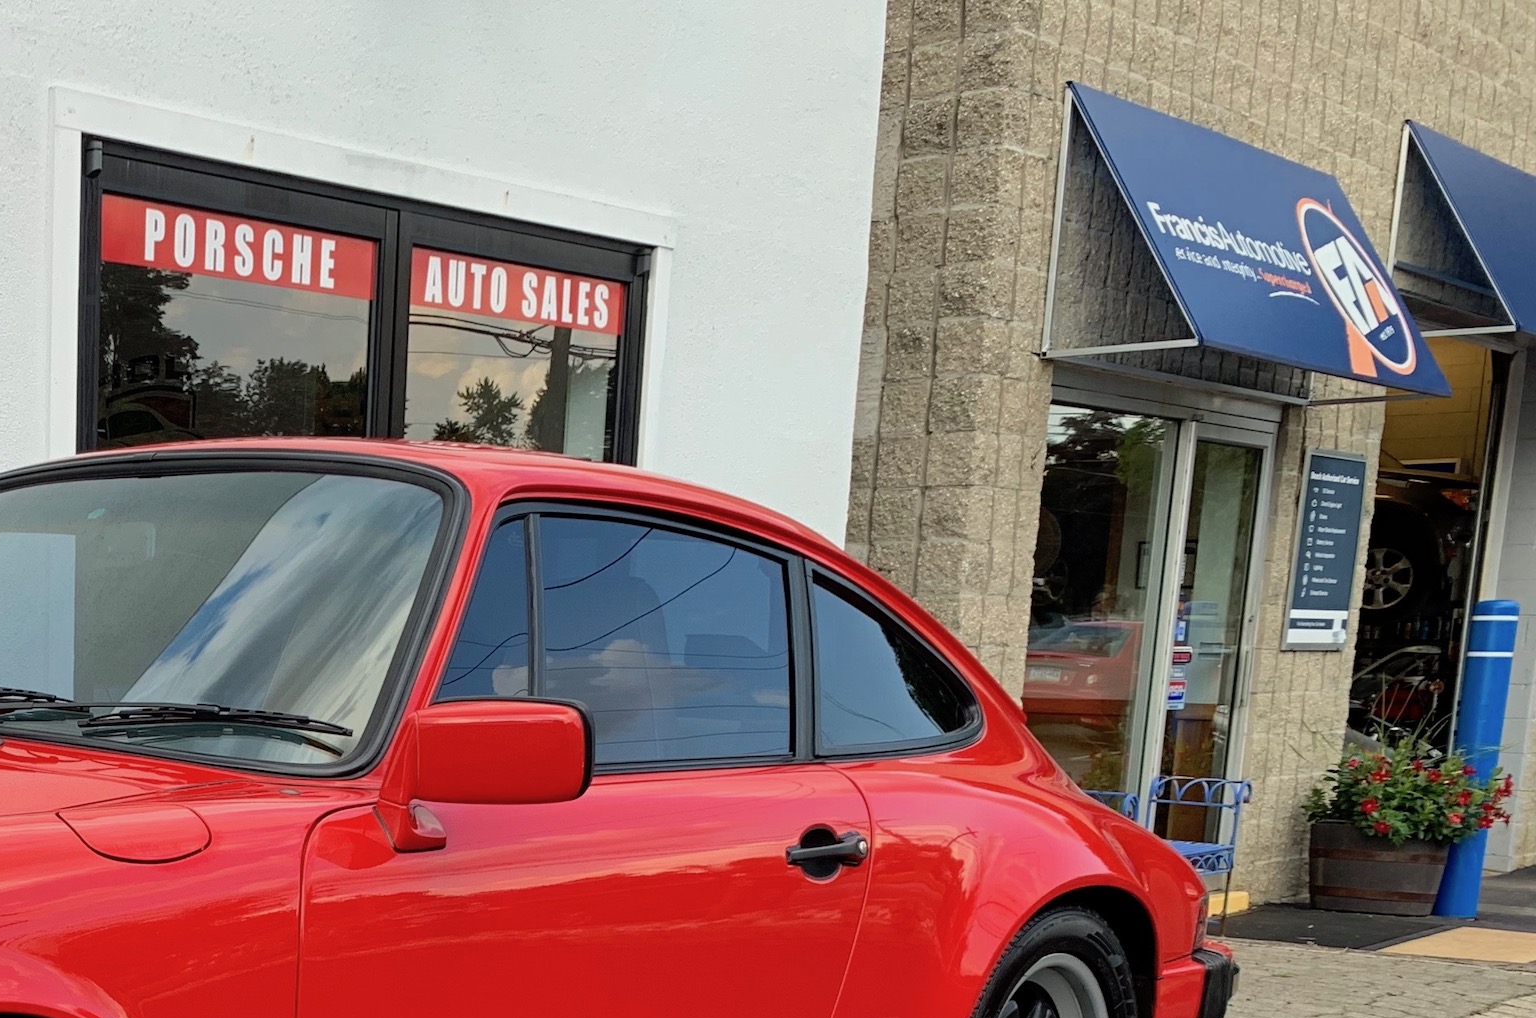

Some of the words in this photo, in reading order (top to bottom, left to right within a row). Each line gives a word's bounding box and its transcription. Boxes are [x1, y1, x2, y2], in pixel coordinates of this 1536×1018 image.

[144, 207, 336, 290] PORSCHE
[424, 255, 508, 314] AUTO
[521, 271, 609, 329] SALES
